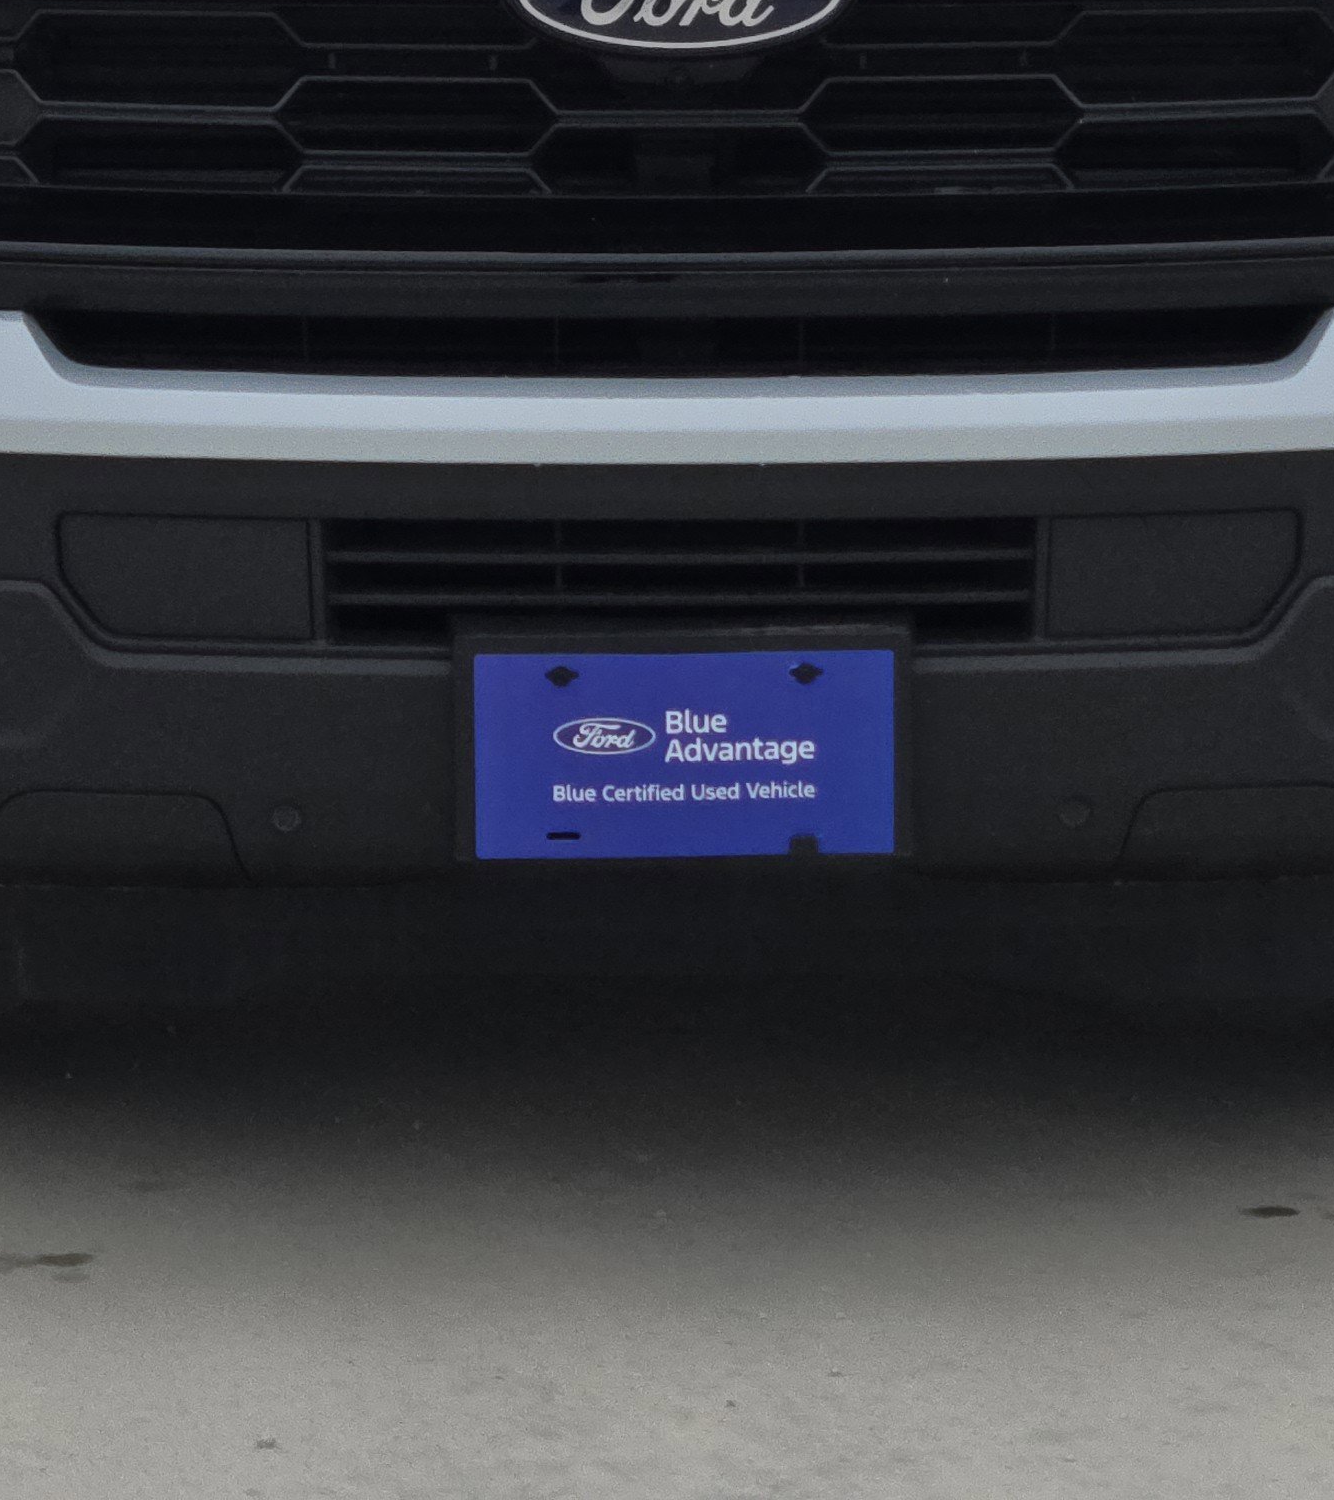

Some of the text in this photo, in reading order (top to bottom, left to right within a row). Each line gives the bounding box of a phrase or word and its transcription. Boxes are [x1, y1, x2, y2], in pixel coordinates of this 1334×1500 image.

[665, 708, 727, 735] Blue
[572, 722, 636, 749] Ford
[665, 737, 815, 765] Advantage
[553, 780, 816, 802] Blue Certified Used Vehicle
